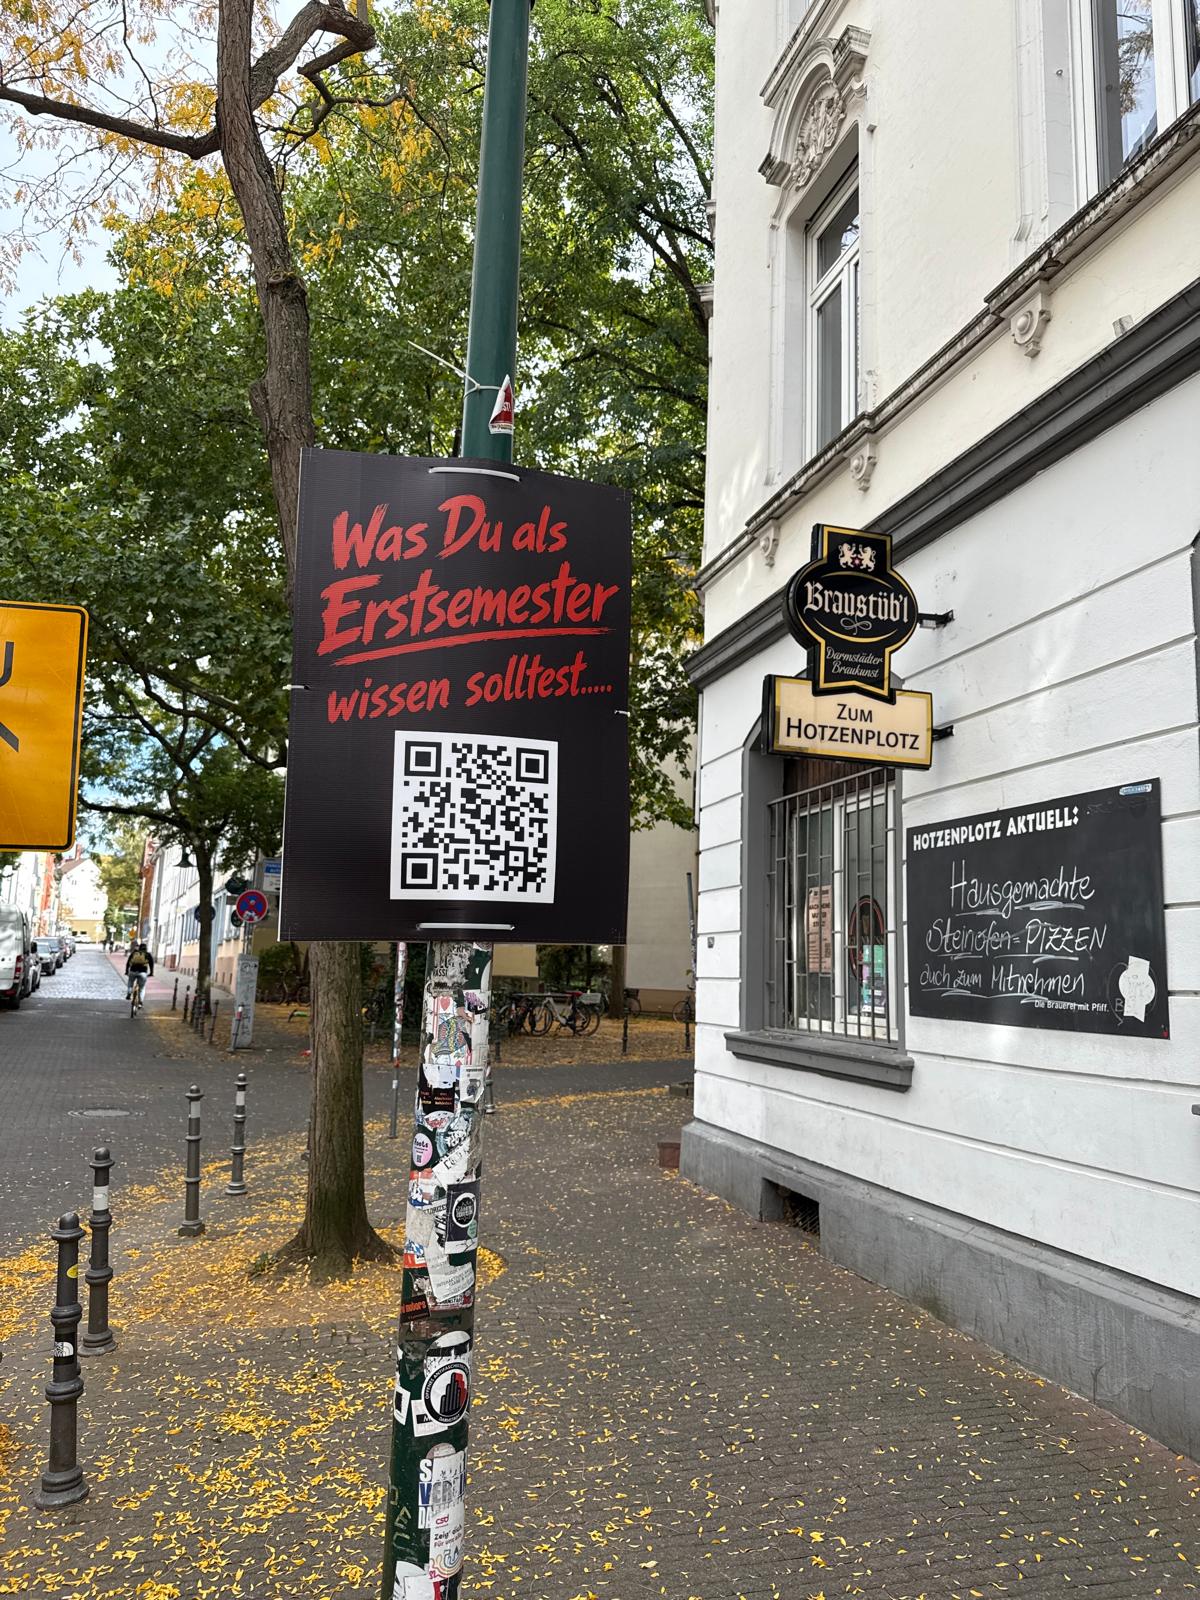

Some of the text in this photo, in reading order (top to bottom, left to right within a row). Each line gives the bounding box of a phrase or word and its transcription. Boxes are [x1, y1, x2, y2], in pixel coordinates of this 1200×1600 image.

[332, 494, 569, 570] Was Du als
[316, 561, 620, 657] Erstsemester
[826, 646, 884, 665] Darmstädter
[831, 660, 880, 679] Braukunst
[327, 678, 450, 724] wissen
[786, 717, 920, 750] HOTZENPLOTZ
[913, 806, 1080, 851] HOTZENPLOTZ AKTUELL:
[950, 859, 1095, 919] Hausgemachte
[1025, 919, 1108, 954] PIZZEN
[919, 963, 1085, 998] auch zum Mitnehmen
[1034, 999, 1046, 1009] Die
[1046, 1000, 1076, 1011] Brauerei
[1077, 1003, 1090, 1012] mit
[1091, 1002, 1110, 1013] Pfiff.
